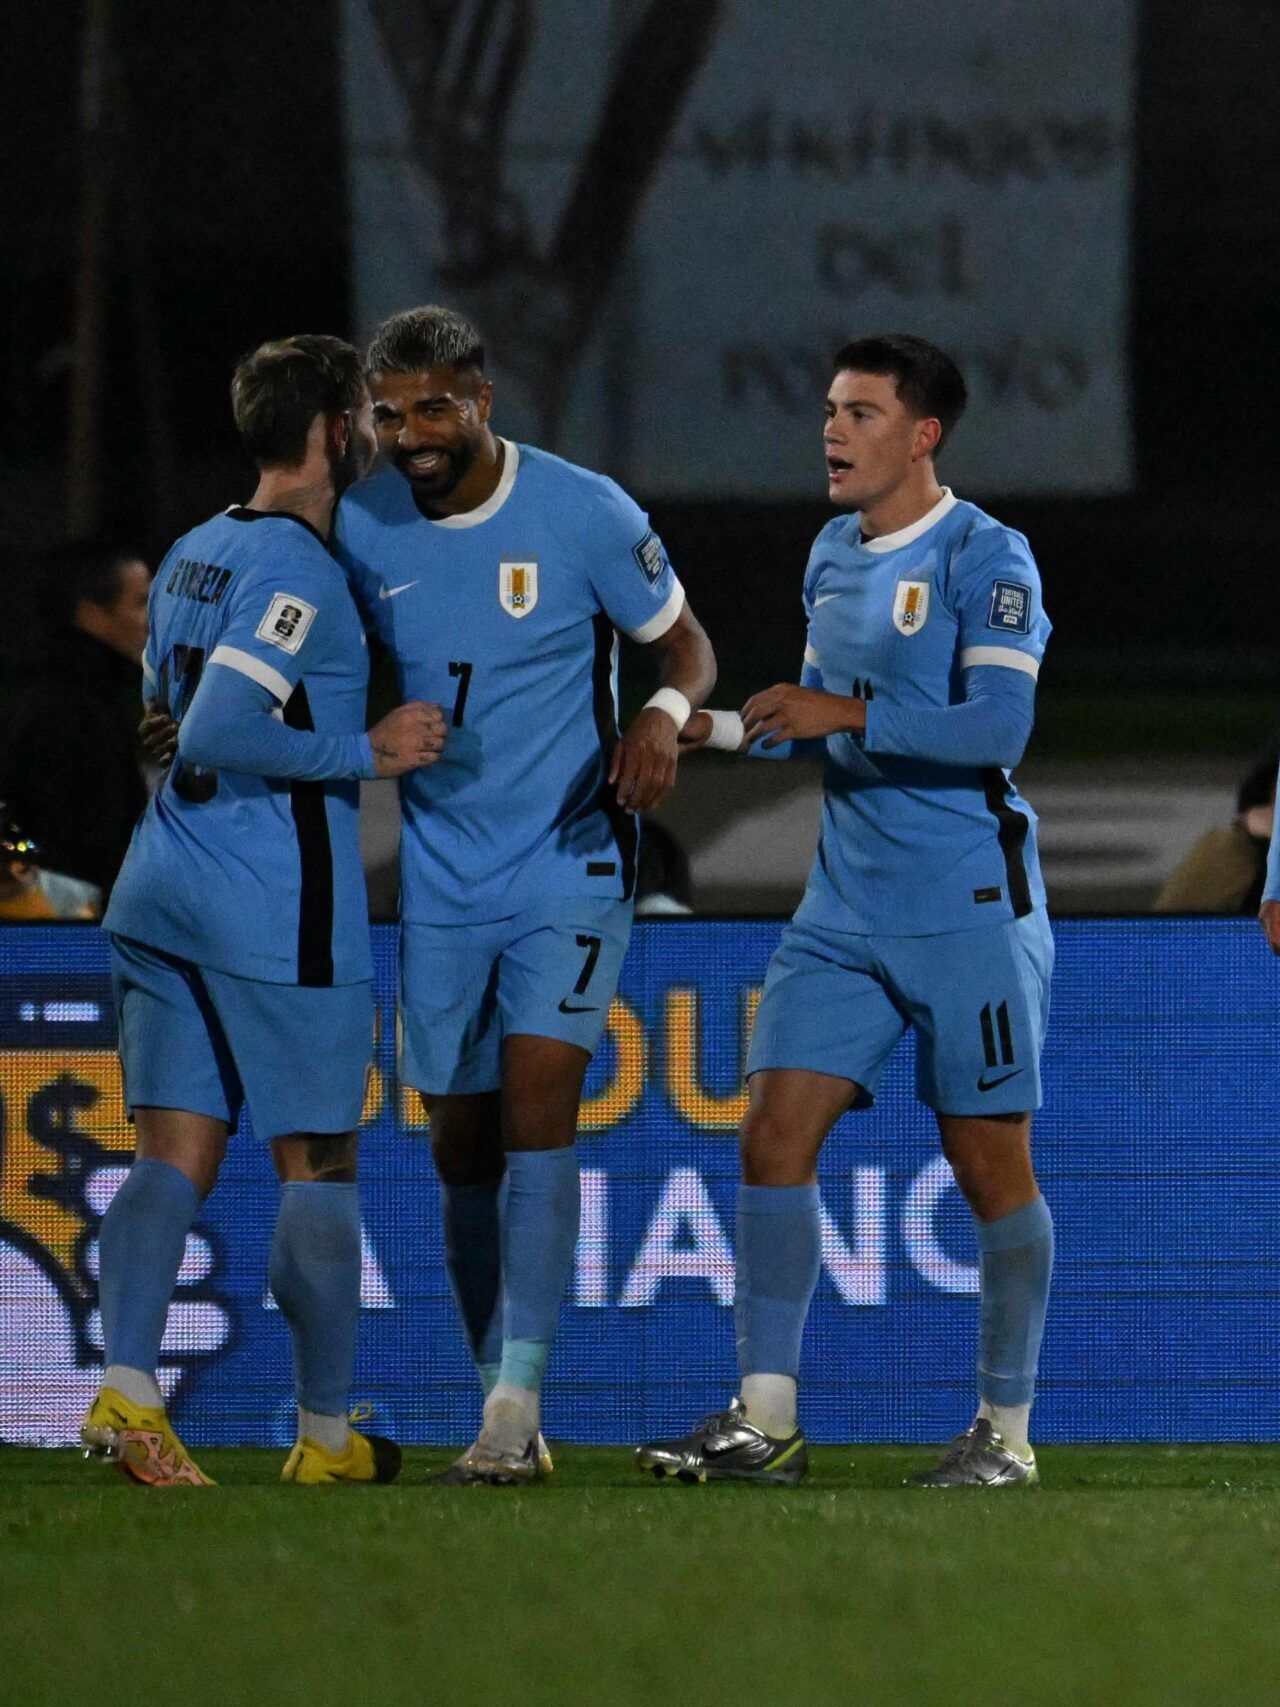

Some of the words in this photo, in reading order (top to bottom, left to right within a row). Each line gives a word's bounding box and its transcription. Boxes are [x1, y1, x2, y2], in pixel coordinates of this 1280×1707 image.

[448, 662, 473, 727] 7
[575, 934, 601, 995] 7
[980, 999, 1014, 1067] 11
